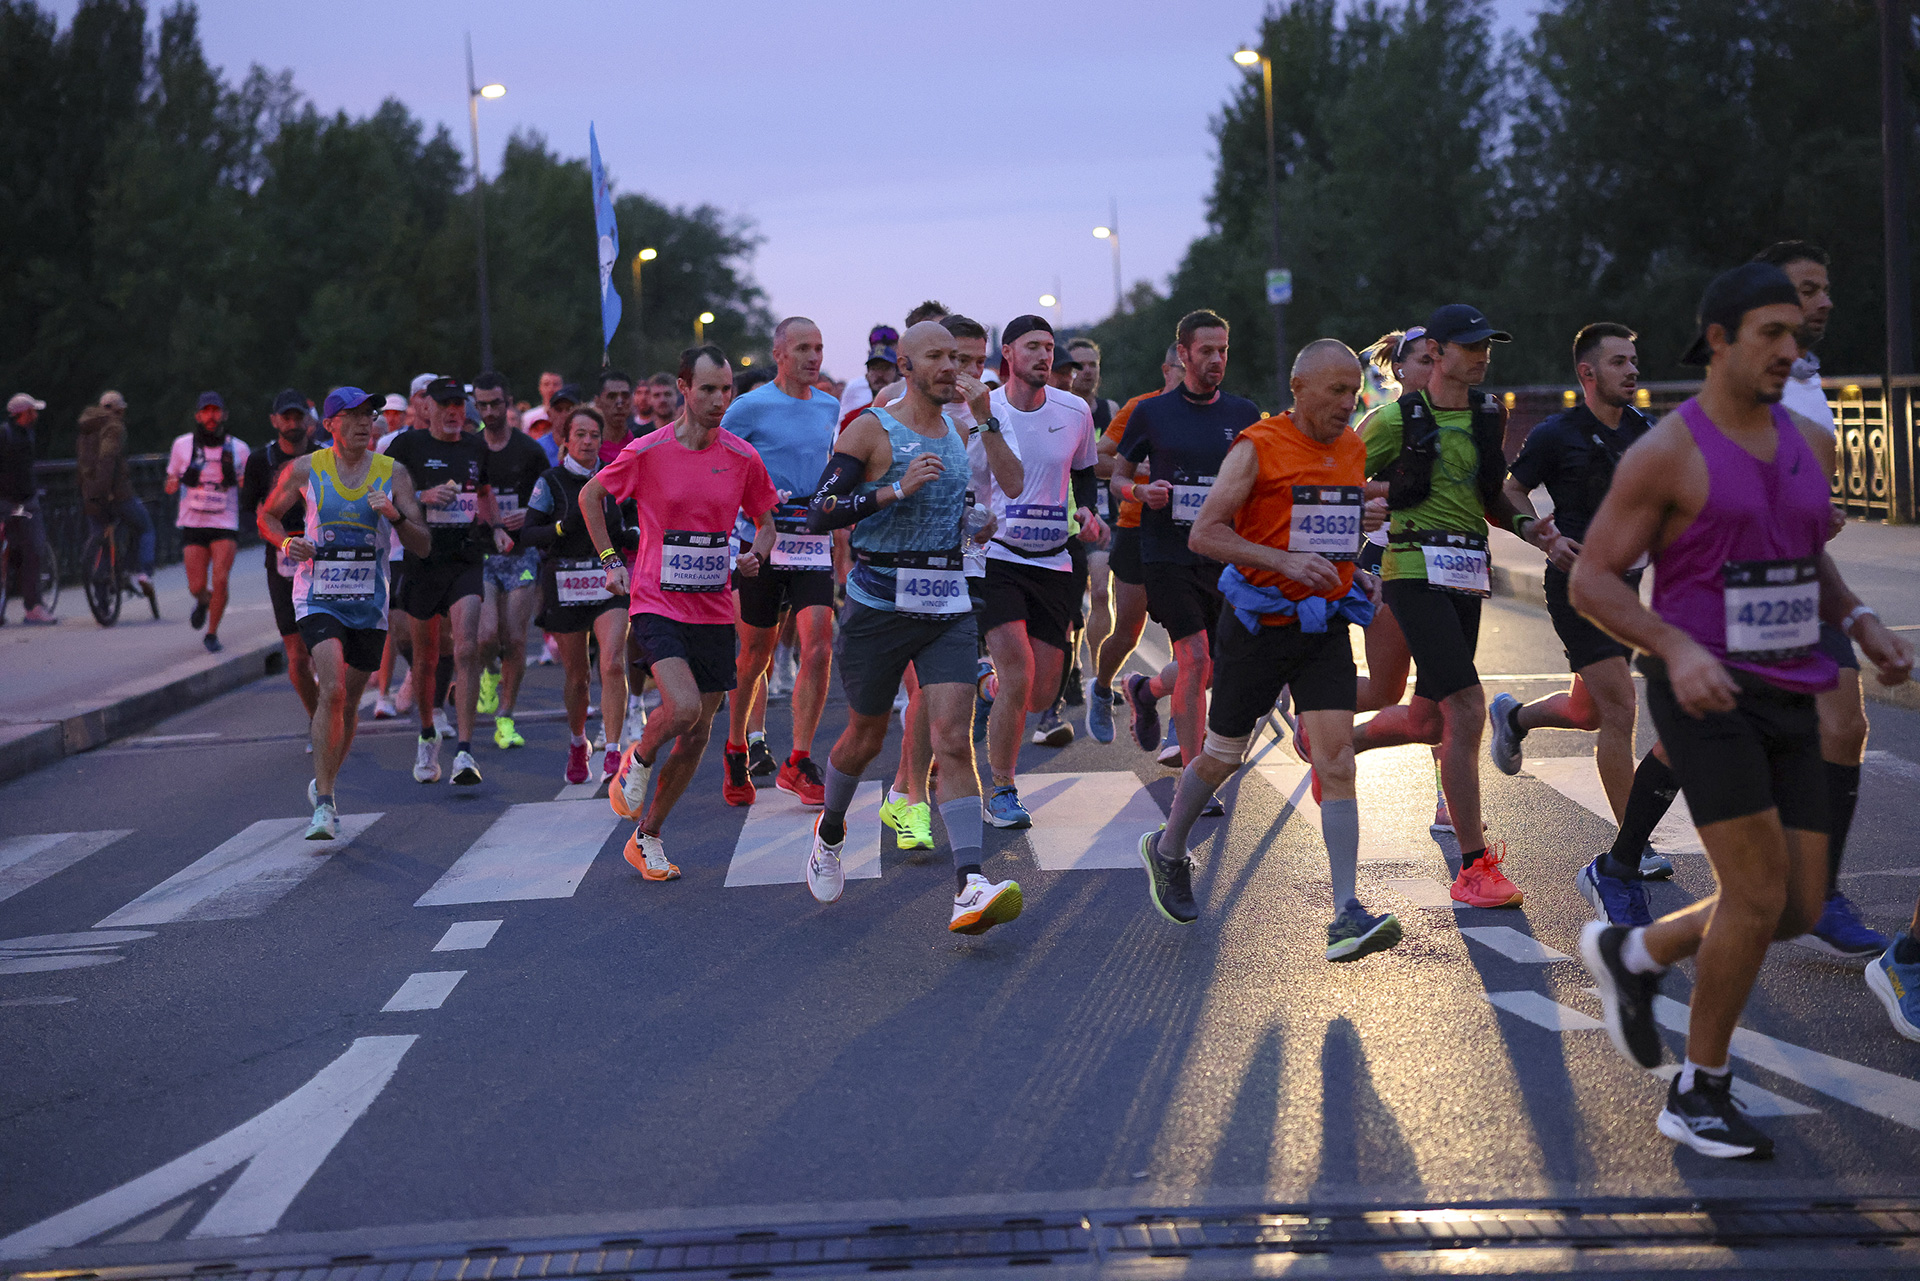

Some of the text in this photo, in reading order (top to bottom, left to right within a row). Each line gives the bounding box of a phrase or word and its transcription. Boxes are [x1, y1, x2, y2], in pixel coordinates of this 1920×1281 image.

[1299, 515, 1356, 534] 43632
[1012, 525, 1062, 542] 52108
[1309, 537, 1350, 546] DOMINIQUE
[777, 540, 824, 555] 42758
[669, 553, 725, 572] 43458
[1433, 554, 1482, 574] 43887
[320, 567, 370, 582] 42747
[562, 575, 608, 590] 42820
[674, 572, 720, 580] PIERRE-ALANN
[324, 583, 364, 591] JEAN-PHILIPPE
[904, 578, 960, 598] 43606
[921, 600, 949, 608] VINCENT
[1738, 597, 1814, 627] 42289
[1885, 966, 1907, 1000] HOKA
